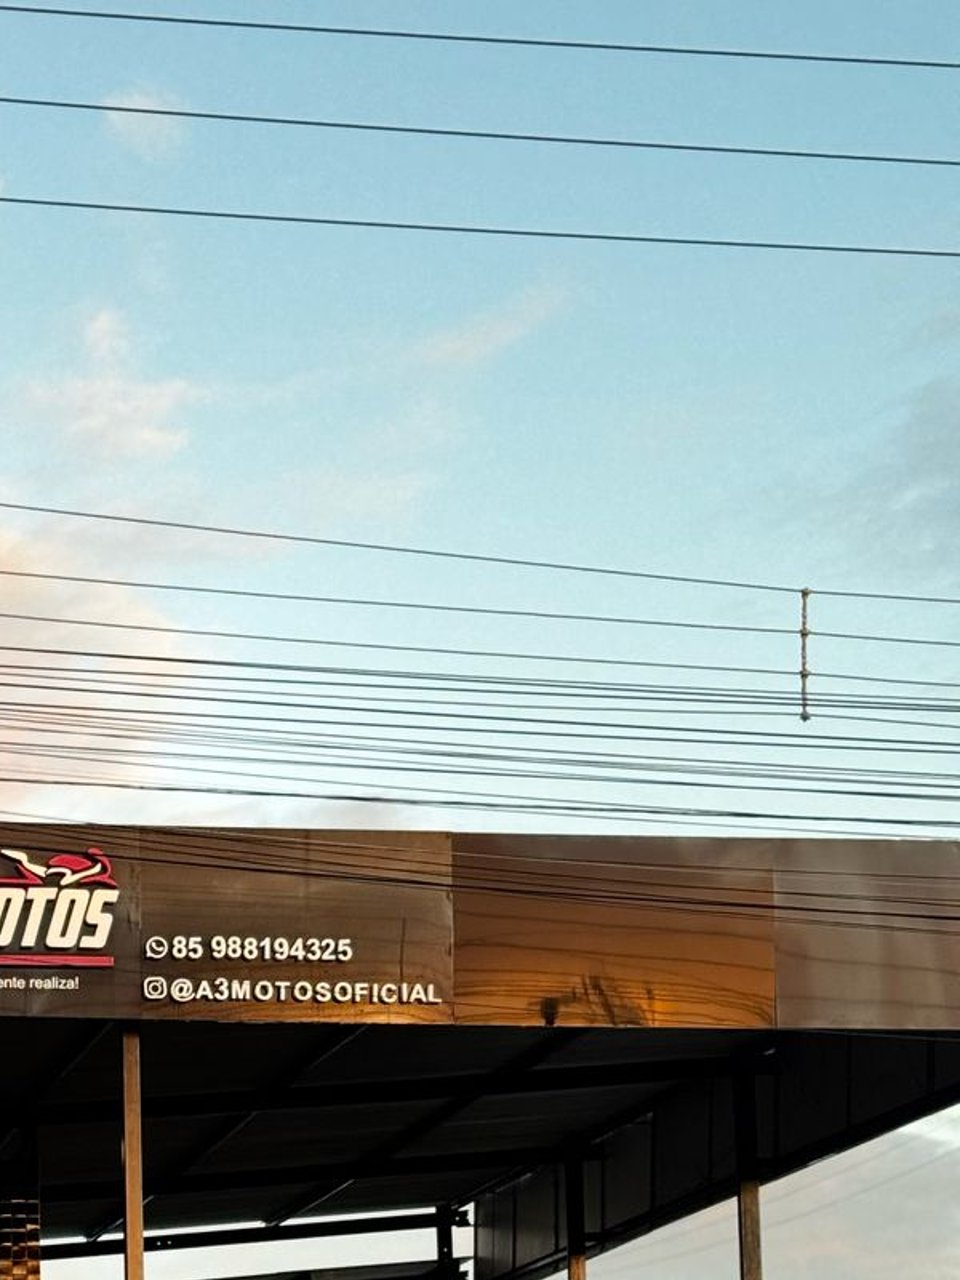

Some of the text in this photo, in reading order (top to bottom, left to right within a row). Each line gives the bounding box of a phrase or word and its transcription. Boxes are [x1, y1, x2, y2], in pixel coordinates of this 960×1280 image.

[171, 935, 353, 962] 85 988194325
[28, 976, 80, 991] realiza!
[169, 977, 443, 1004] @A3MOTOSOFICIAL
